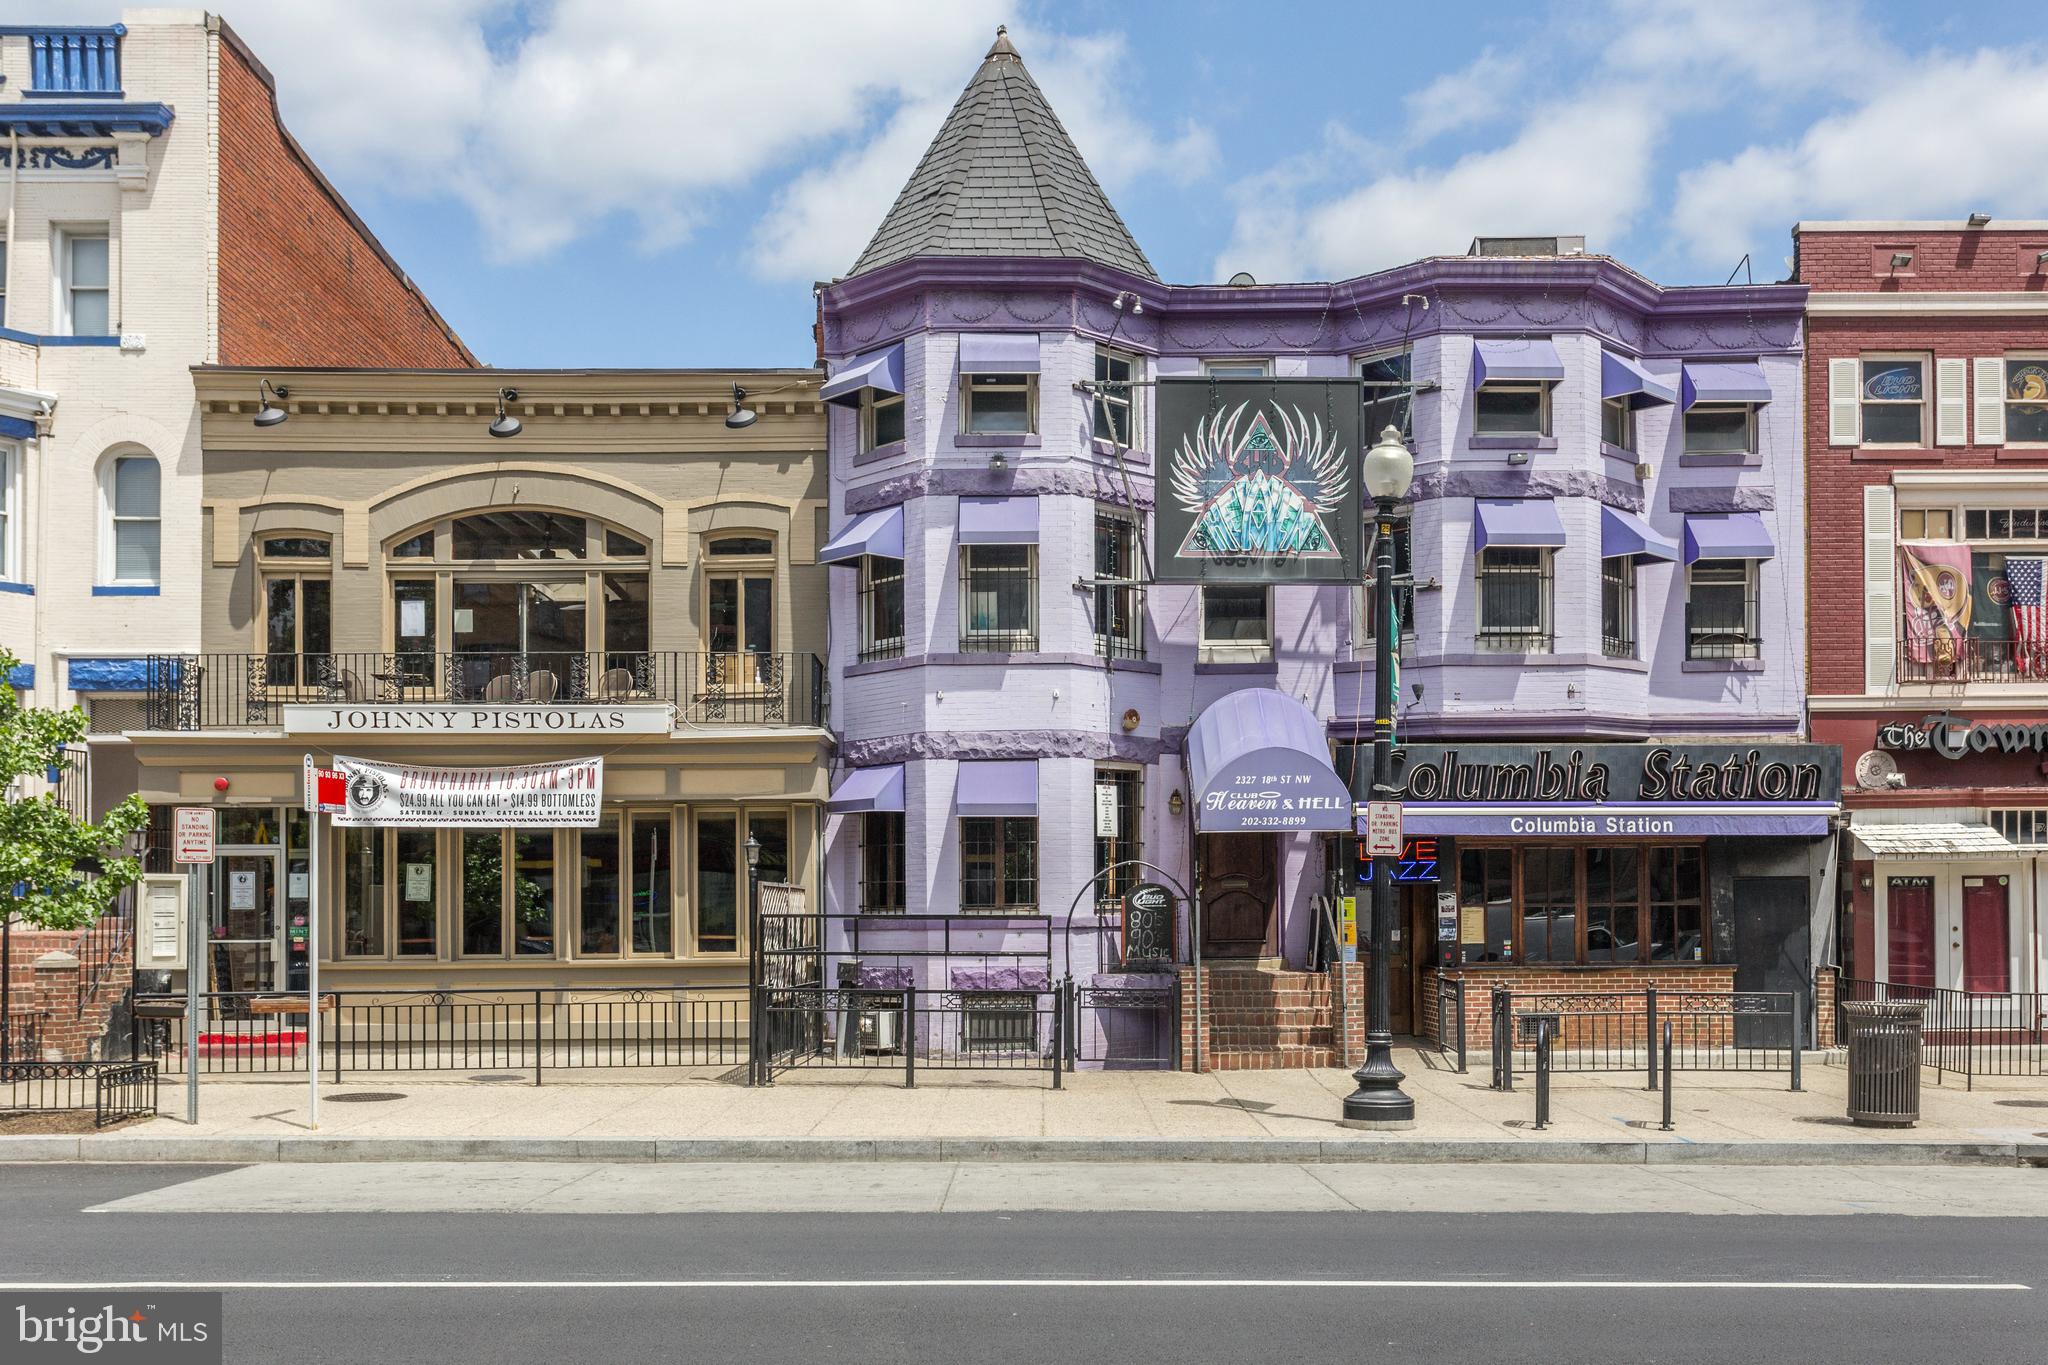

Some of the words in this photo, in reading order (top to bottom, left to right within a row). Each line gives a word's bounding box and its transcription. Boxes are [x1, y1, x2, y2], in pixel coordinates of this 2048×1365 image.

[1874, 384, 1920, 395] LIGHT
[1881, 375, 1916, 386] BUD
[1202, 469, 1317, 553] HEAVEN
[328, 710, 458, 730] JOHNNY
[471, 710, 625, 730] PISTOLAS
[1883, 723, 1927, 750] The
[400, 770, 491, 791] BRUNCHARIA
[1235, 776, 1256, 784] 2327
[1262, 775, 1277, 784] 18th
[1280, 775, 1292, 784] ST
[1295, 775, 1311, 784] NW
[1638, 748, 1822, 801] Station
[400, 792, 427, 808] $24.99
[430, 793, 444, 807] ALL
[448, 794, 463, 807] YOU
[467, 793, 483, 807] CAN
[486, 793, 500, 807] EAT
[510, 793, 538, 808] $14.99
[541, 793, 596, 807] BOTTOMLESS
[1206, 790, 1278, 810] Heaven
[1282, 799, 1294, 810] &
[1299, 797, 1344, 809] HELL
[1241, 817, 1306, 826] 202-332-8899
[1510, 817, 1596, 833] Columbia
[1606, 817, 1673, 833] Station
[1359, 841, 1438, 860] LVE
[1359, 860, 1438, 881] JZZ
[1891, 879, 1929, 887] ATM
